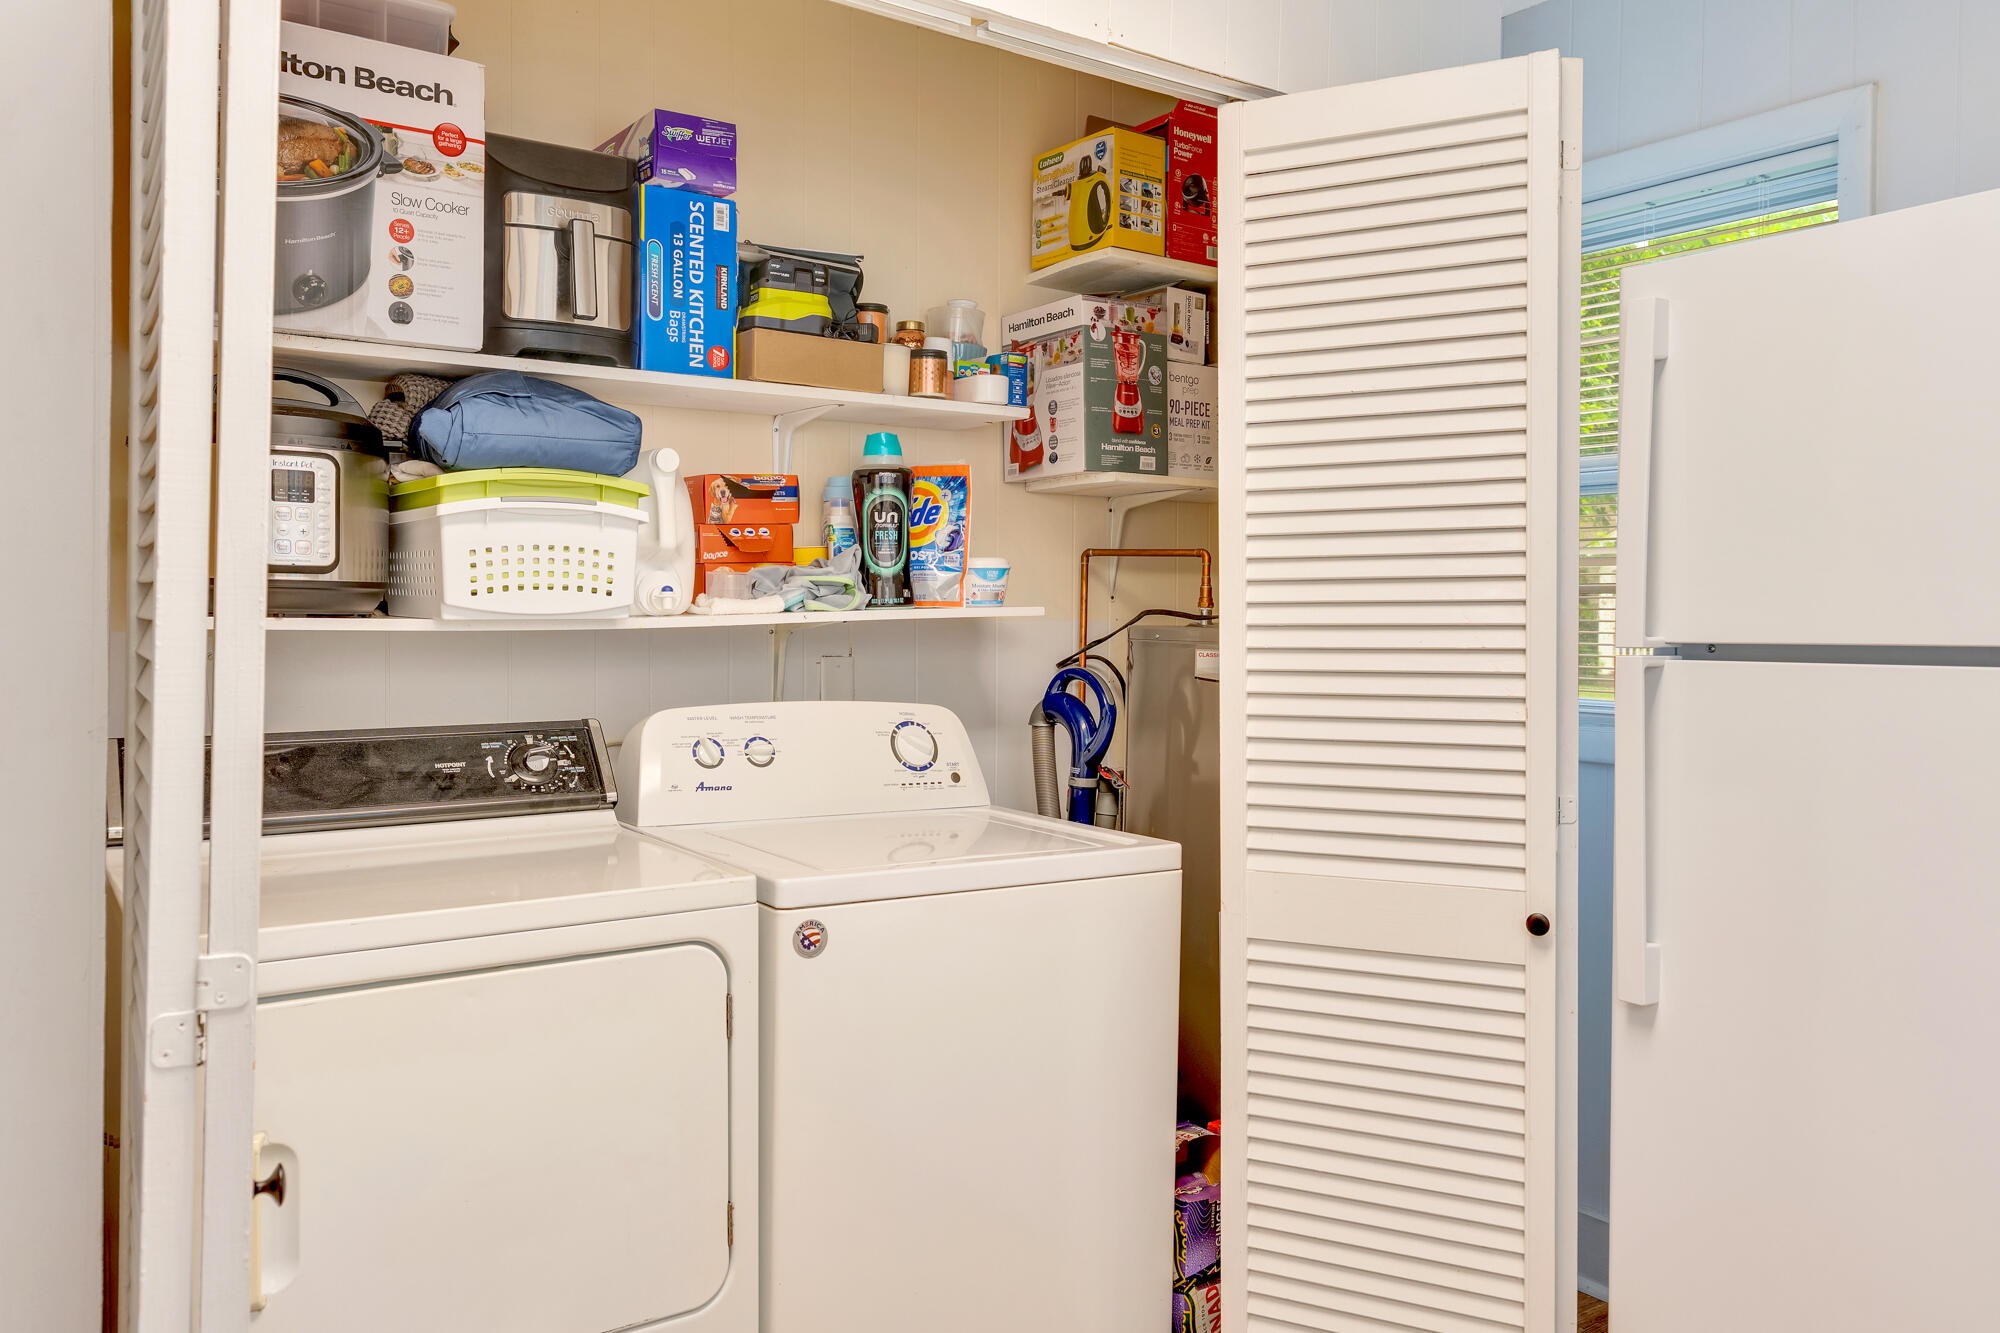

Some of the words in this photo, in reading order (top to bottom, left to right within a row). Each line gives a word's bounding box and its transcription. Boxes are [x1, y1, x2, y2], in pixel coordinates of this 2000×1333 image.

[354, 66, 454, 107] Beach
[441, 130, 460, 139] Perfect
[661, 125, 693, 142] Swiffer
[695, 134, 733, 147] WETJET
[1173, 126, 1212, 145] Honeywell
[438, 140, 462, 151] gathering
[1173, 147, 1193, 159] Power
[391, 191, 423, 209] Slow
[424, 197, 471, 216] Cooker
[394, 226, 409, 234] 12+
[672, 233, 684, 247] 13
[688, 200, 705, 285] SCENTED
[650, 254, 660, 279] FRESH
[672, 249, 684, 300] GALLON
[650, 280, 660, 306] SCENT
[720, 267, 729, 310] KIRKLAND
[668, 310, 681, 343] Bags
[688, 288, 705, 369] KITCHEN
[1008, 316, 1046, 333] Hamilton
[1046, 307, 1075, 323] Beach
[713, 348, 725, 358] 7
[1168, 371, 1200, 388] bentgo
[1169, 399, 1211, 418] 90-PIECE
[1169, 416, 1185, 428] MEAL
[1185, 418, 1201, 429] PREP
[1201, 420, 1211, 431] KIT
[1101, 443, 1134, 452] Hamilton
[1134, 445, 1156, 454] Beach
[874, 511, 899, 524] un
[874, 530, 899, 541] FRESH
[703, 550, 729, 560] bounce
[434, 761, 467, 769] HOTPOINT
[695, 781, 733, 793] Amana
[795, 920, 825, 937] AMERICA
